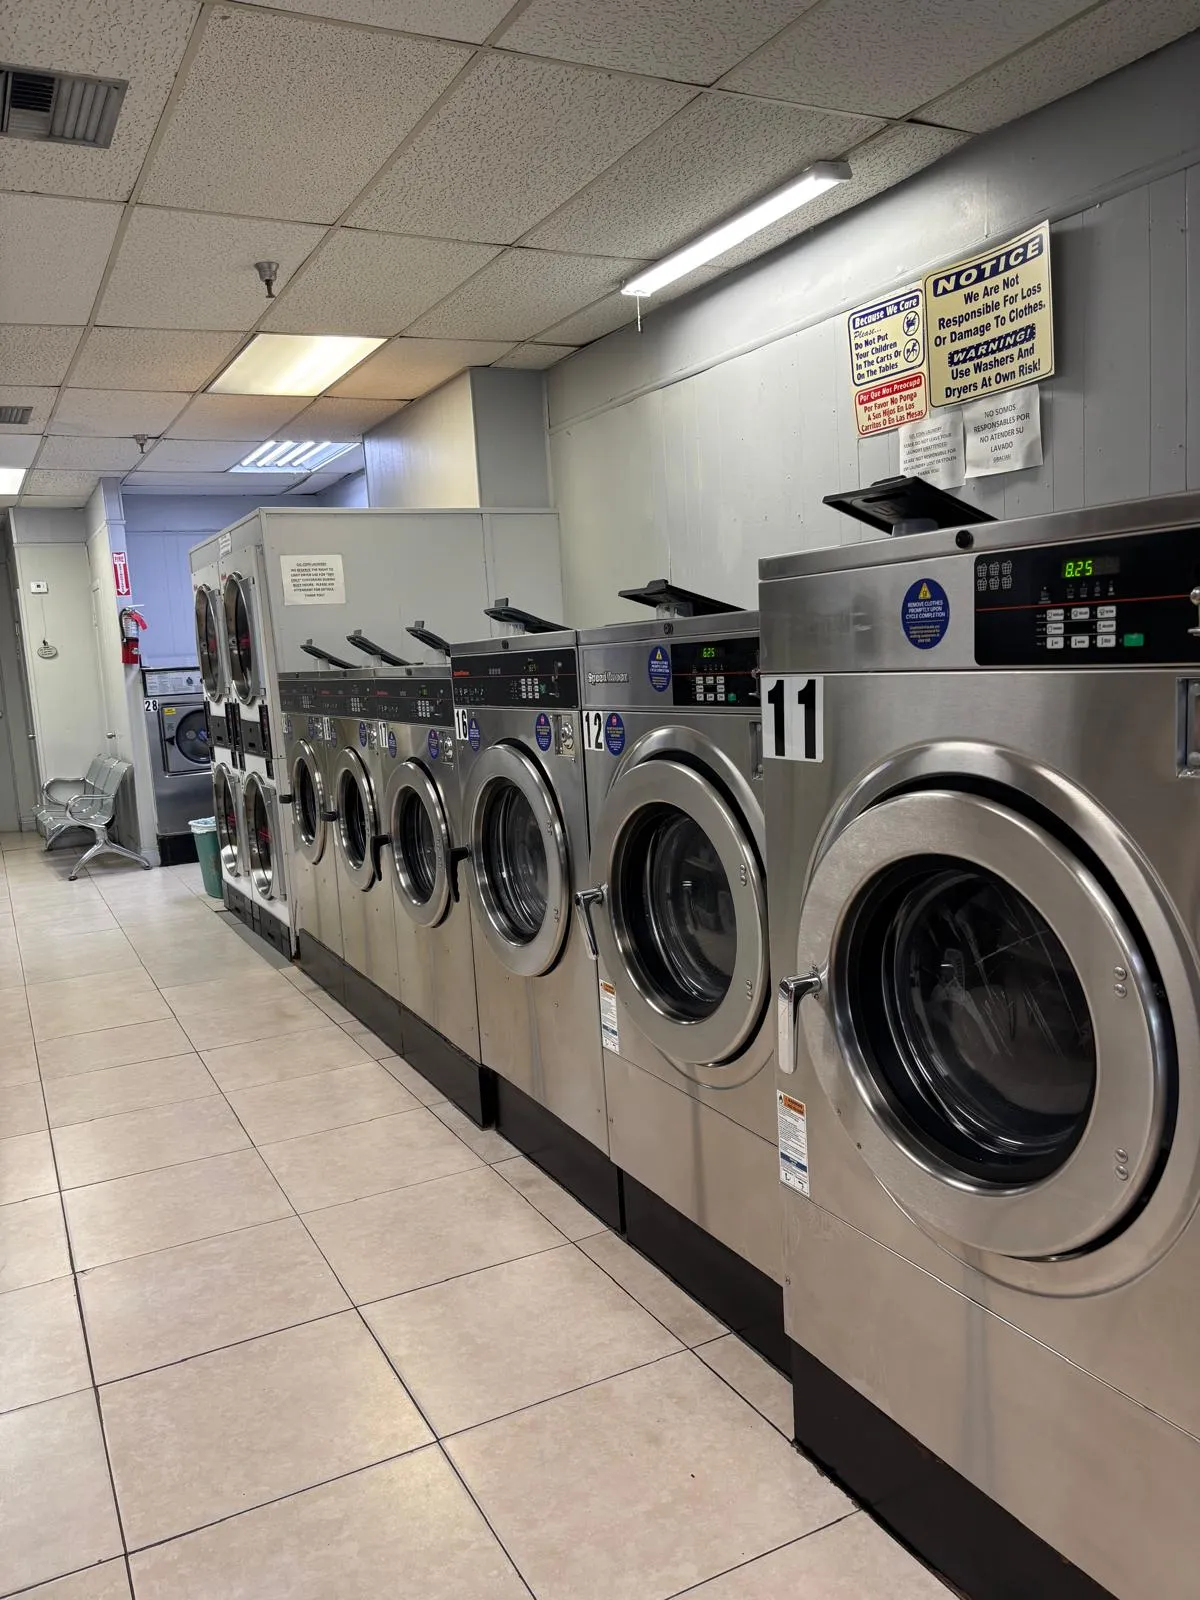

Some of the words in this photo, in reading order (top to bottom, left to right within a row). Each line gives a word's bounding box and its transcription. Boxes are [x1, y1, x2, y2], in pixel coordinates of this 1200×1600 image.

[937, 237, 1040, 295] NOTICE
[963, 291, 979, 305] We
[982, 284, 999, 298] Are
[1002, 273, 1019, 290] Not
[854, 310, 884, 328] Because
[886, 304, 898, 316] We
[900, 298, 917, 311] Care
[938, 299, 1000, 330] Responsible
[1003, 290, 1018, 307] For
[1021, 283, 1042, 300] Loss
[934, 335, 947, 347] Or
[950, 322, 991, 343] Damage
[994, 315, 1006, 328] To
[1008, 300, 1046, 323] Clothes.
[854, 342, 863, 350] Do
[864, 337, 876, 347] Not
[877, 333, 888, 343] Put
[856, 351, 869, 361] Your
[871, 341, 897, 355] Children
[953, 329, 1031, 362] WARNING!
[856, 363, 862, 371] In
[863, 359, 875, 368] The
[876, 353, 892, 364] Carts
[893, 349, 902, 357] Or
[951, 368, 971, 380] Use
[973, 353, 1014, 374] Washers
[1017, 343, 1035, 360] And
[856, 371, 865, 381] On
[866, 369, 877, 377] The
[878, 362, 899, 373] Tables
[945, 382, 978, 398] Dryers
[981, 376, 992, 389] At
[995, 370, 1016, 385] Own
[1018, 358, 1041, 377] Risk!
[859, 394, 869, 402] Por
[870, 391, 880, 399] Que
[881, 387, 893, 396] Nos
[864, 405, 873, 413] Por
[874, 401, 889, 410] Favor
[890, 396, 898, 404] No
[899, 391, 917, 402] Ponga
[861, 421, 882, 432] Carritos
[888, 417, 895, 425] En
[896, 413, 906, 422] Las
[906, 410, 924, 420] Mesas
[872, 412, 882, 420] Sus
[882, 408, 896, 418] Hijos
[897, 405, 904, 413] En
[905, 402, 915, 411] Los
[984, 410, 994, 419] NO
[995, 403, 1016, 416] SOMOS
[974, 417, 1016, 433] RESPONSABLES
[1016, 412, 1031, 421] POR
[980, 435, 989, 444] NO
[990, 428, 1015, 441] ATENDER
[1016, 426, 1024, 434] SU
[991, 441, 1013, 453] LAVADO
[1065, 560, 1093, 578] 8.25
[588, 672, 607, 685] Speed
[145, 700, 158, 712] 28
[456, 710, 467, 739] 16
[767, 679, 816, 759] 11
[585, 712, 603, 749] 12
